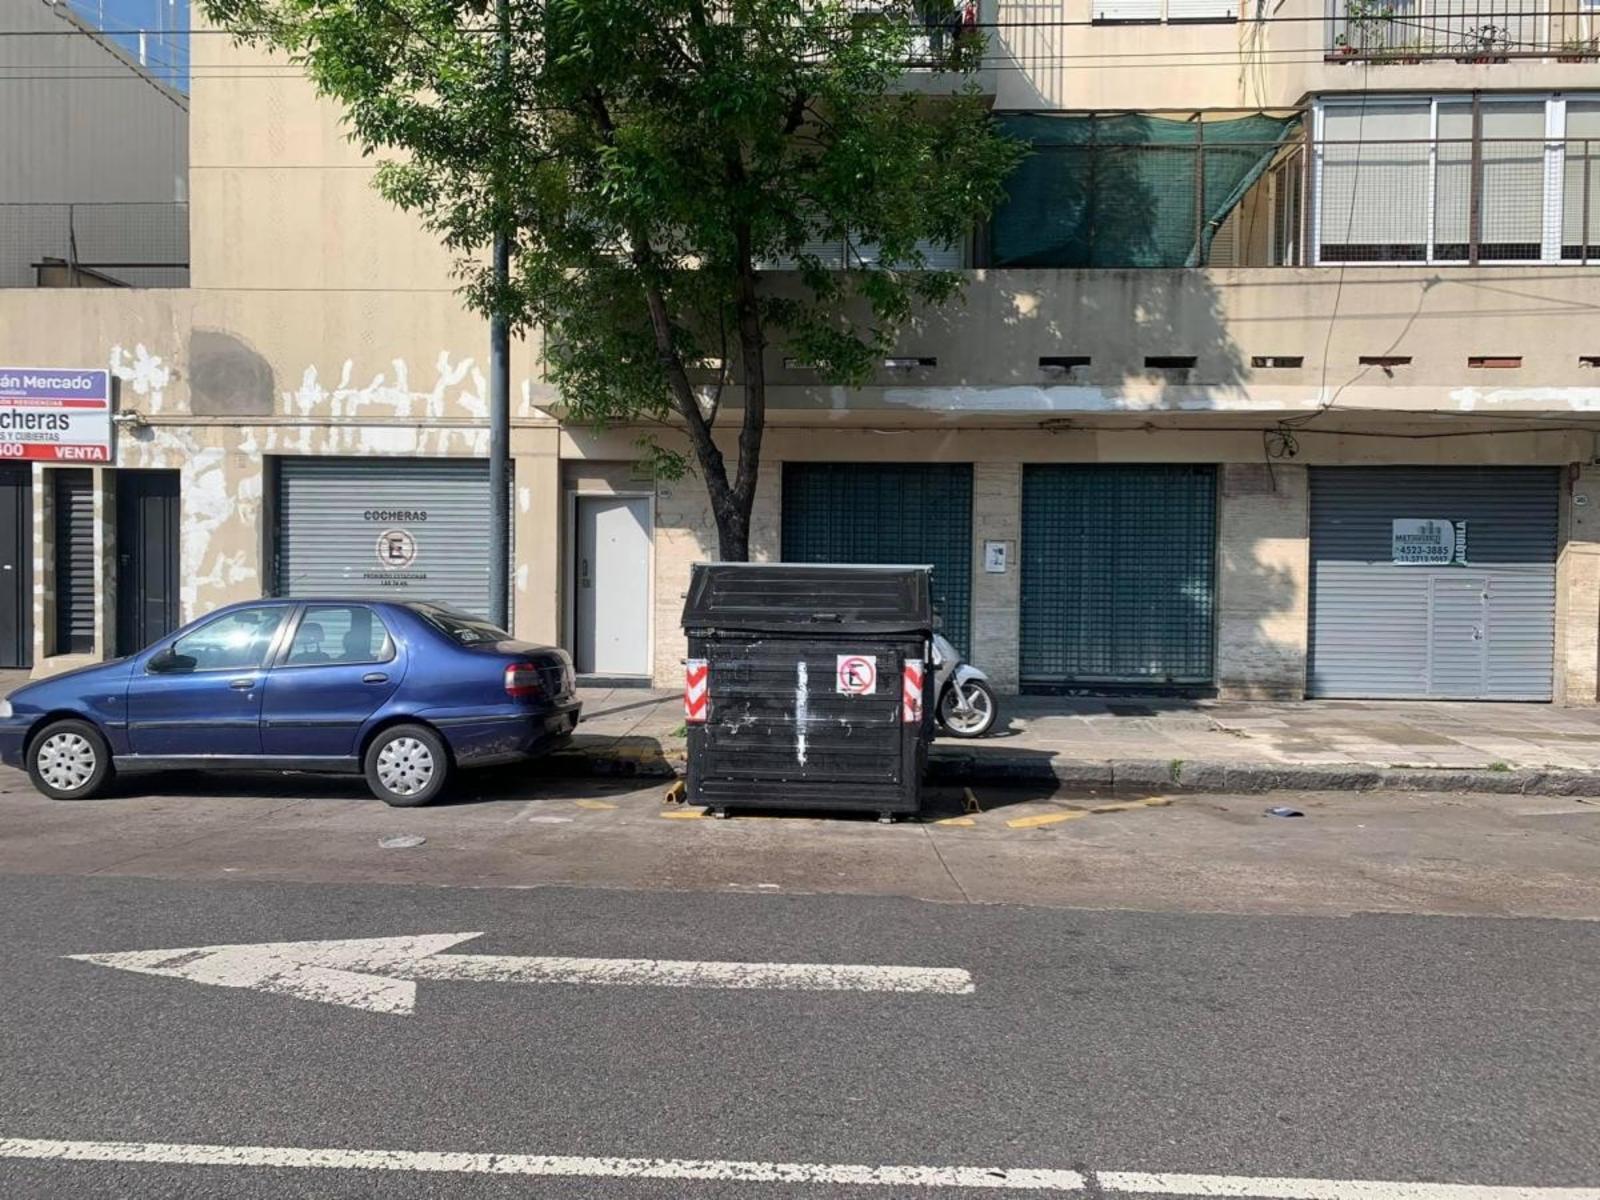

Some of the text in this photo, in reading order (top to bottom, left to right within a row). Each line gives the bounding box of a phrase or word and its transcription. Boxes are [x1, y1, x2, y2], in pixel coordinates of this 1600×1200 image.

[23, 375, 93, 390] Mercado
[0, 408, 69, 430] cheras
[8, 432, 14, 440] Y
[15, 432, 60, 441] CUBIERTAS
[54, 446, 103, 459] VENTA
[364, 511, 427, 521] COCHERAS
[389, 538, 403, 558] E
[1455, 521, 1467, 563] ALQUILA
[849, 663, 864, 686] E
